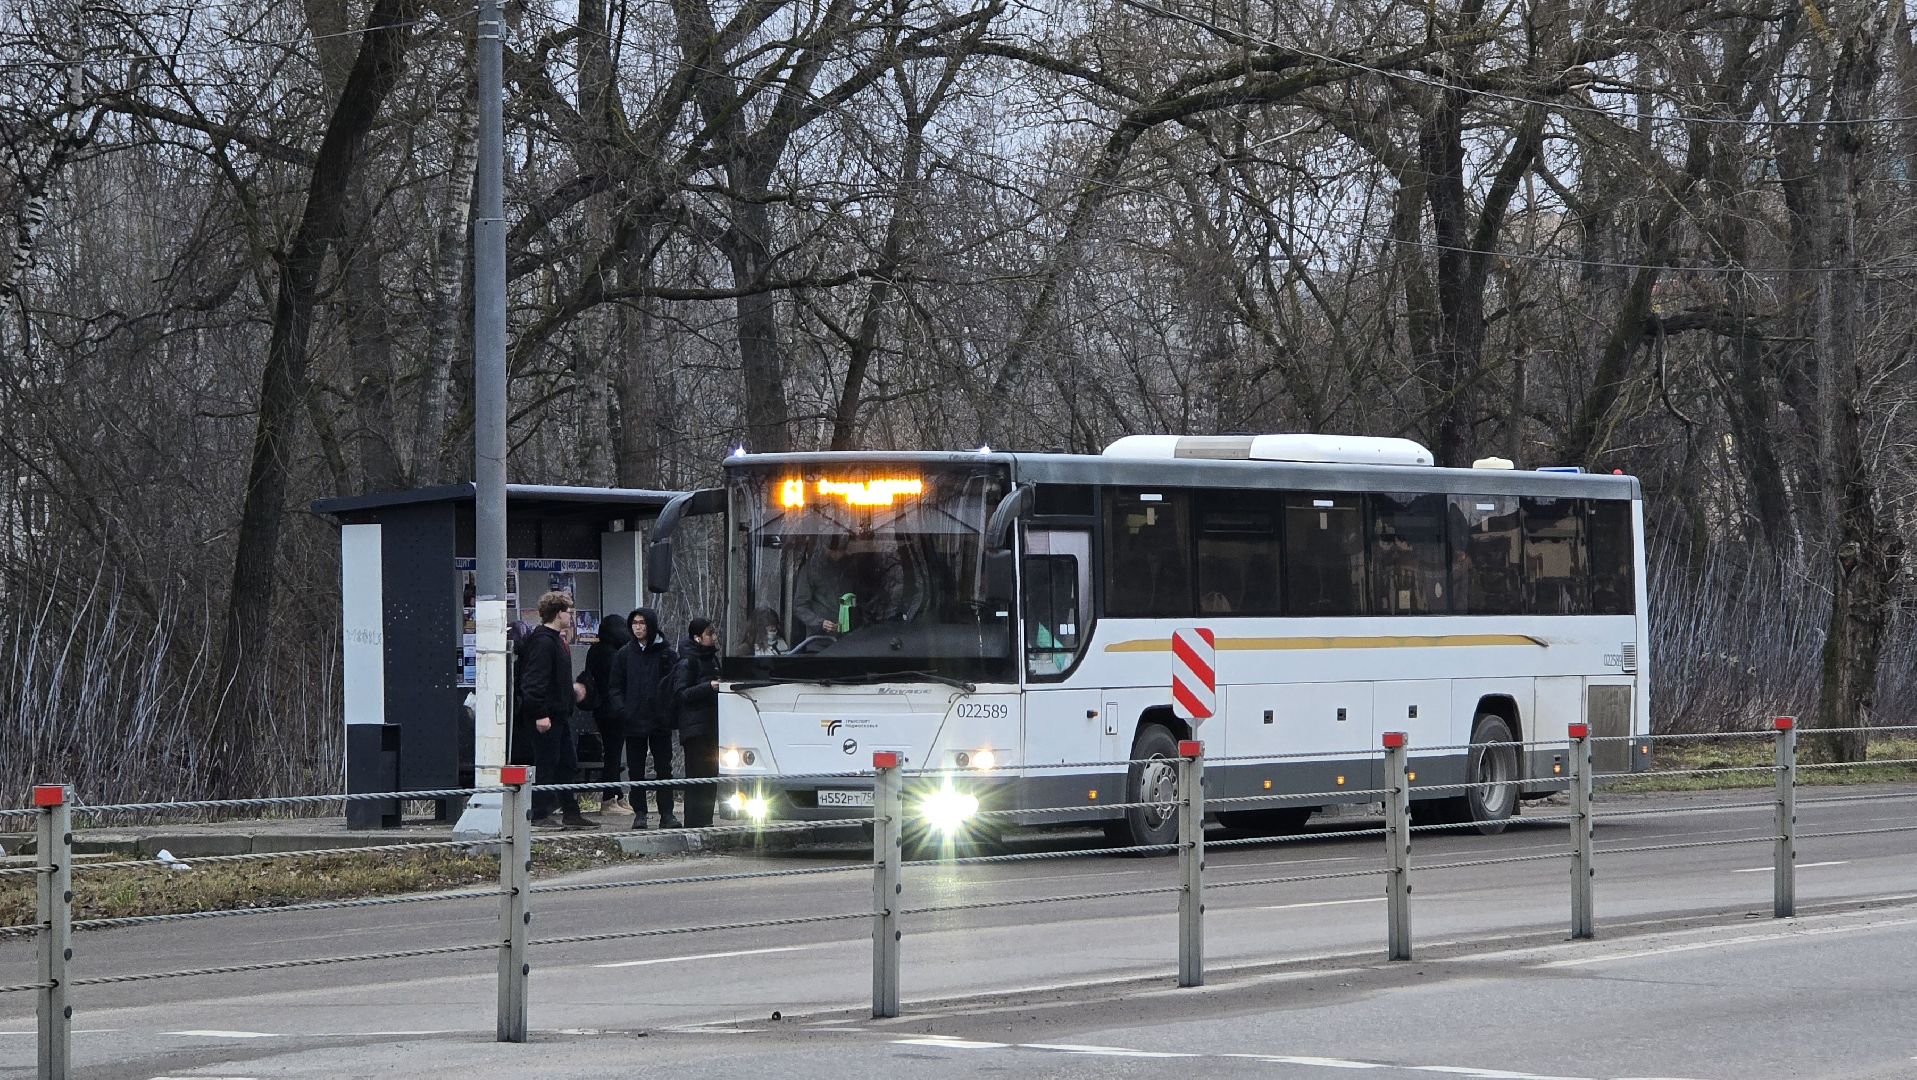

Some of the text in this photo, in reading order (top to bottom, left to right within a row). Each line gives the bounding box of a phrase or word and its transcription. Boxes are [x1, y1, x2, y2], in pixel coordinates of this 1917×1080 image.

[524, 559, 556, 569] ИНФОЩИТ
[956, 703, 1008, 719] 022589
[821, 792, 861, 804] Н552РТ
